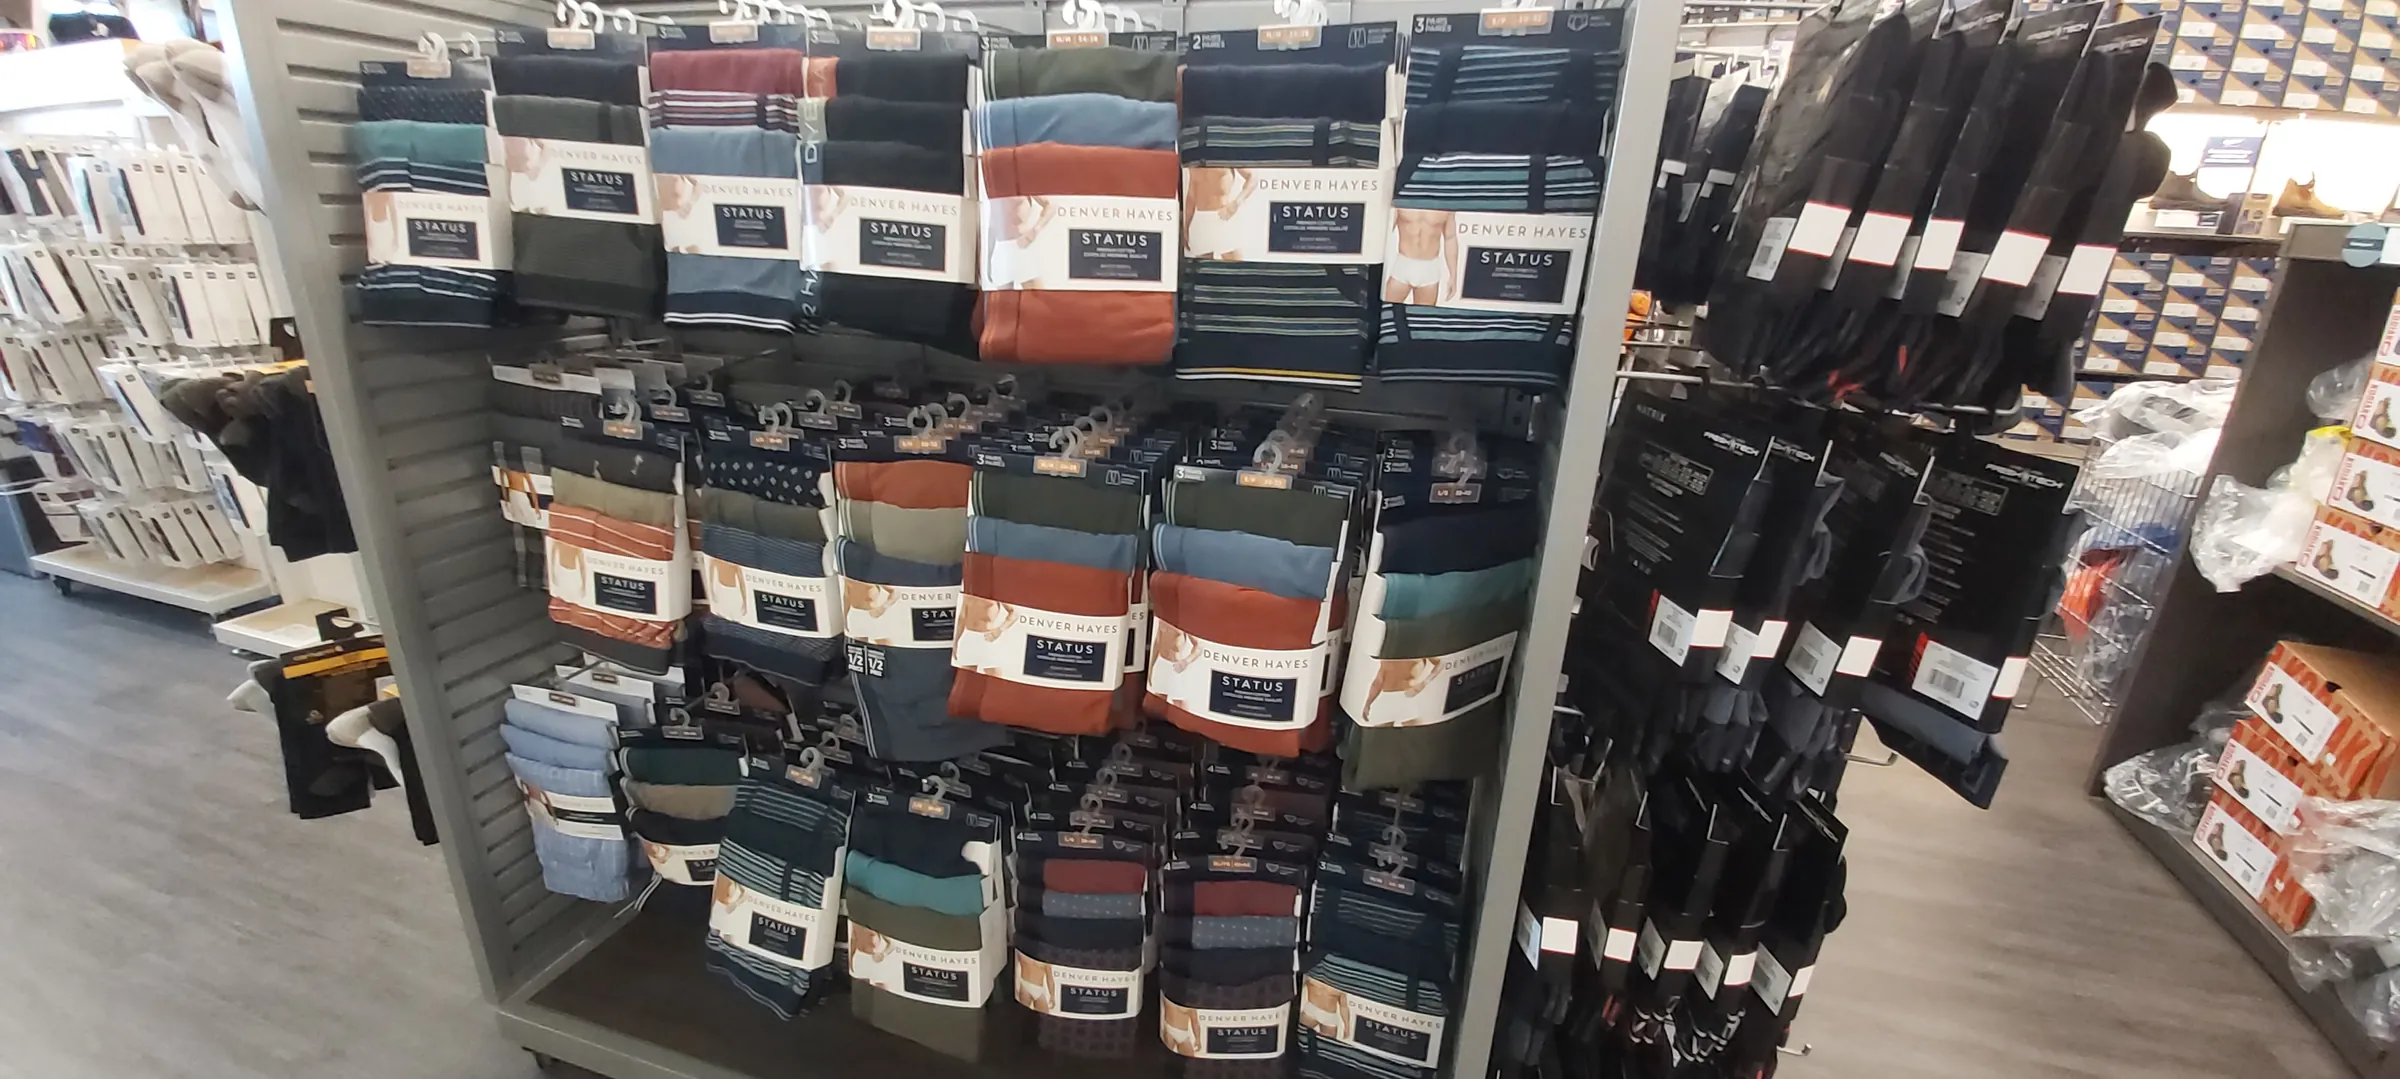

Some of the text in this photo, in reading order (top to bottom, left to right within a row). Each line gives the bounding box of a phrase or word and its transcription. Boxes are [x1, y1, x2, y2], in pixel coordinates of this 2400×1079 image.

[1415, 17, 1424, 33] 3
[1193, 35, 1201, 50] 2
[570, 171, 623, 185] STATUS
[703, 185, 794, 197] DENVER HAYES
[1259, 179, 1379, 192] DENVER HAYES
[850, 196, 958, 216] DENVER HAYES
[1282, 205, 1349, 219] STATUS
[723, 207, 774, 220] STATUS
[1057, 206, 1173, 221] DENVER HAYES
[415, 221, 467, 233] STATUS
[869, 222, 932, 239] STATUS
[1458, 222, 1588, 239] DENVER HAYES
[1082, 232, 1148, 247] STATUS
[1480, 251, 1553, 267] STATUS
[884, 417, 891, 426] 3
[838, 439, 847, 449] 3
[1027, 433, 1034, 442] 3
[1210, 440, 1218, 450] 3
[977, 454, 985, 465] 3
[1387, 448, 1394, 459] 3
[1176, 468, 1184, 479] 3
[1384, 462, 1392, 472] 3
[601, 576, 645, 590] STATUS
[745, 574, 822, 592] DENVER HAYES
[762, 594, 805, 609] STATUS
[901, 592, 952, 601] DENVER
[922, 610, 955, 619] STAT
[1019, 615, 1118, 634] DENVER HAYES
[1037, 640, 1093, 654] STATUS
[848, 653, 864, 667] 1/2
[868, 658, 883, 671] 1/2
[1203, 649, 1309, 669] DENVER HAYES
[1222, 676, 1284, 692] STATUS
[867, 793, 874, 803] 3
[1320, 861, 1327, 870] 3
[785, 909, 816, 923] HAYES
[758, 917, 797, 936] STATUS
[895, 947, 977, 965] DENVER HAYES
[911, 966, 957, 981] STATUS
[1054, 970, 1097, 981] DENVER
[1070, 988, 1117, 997] STATUS
[1348, 1000, 1397, 1020] DENVER
[1199, 1014, 1247, 1022] DENVER
[1217, 1028, 1267, 1036] STATUS
[1365, 1020, 1418, 1040] STATUS
